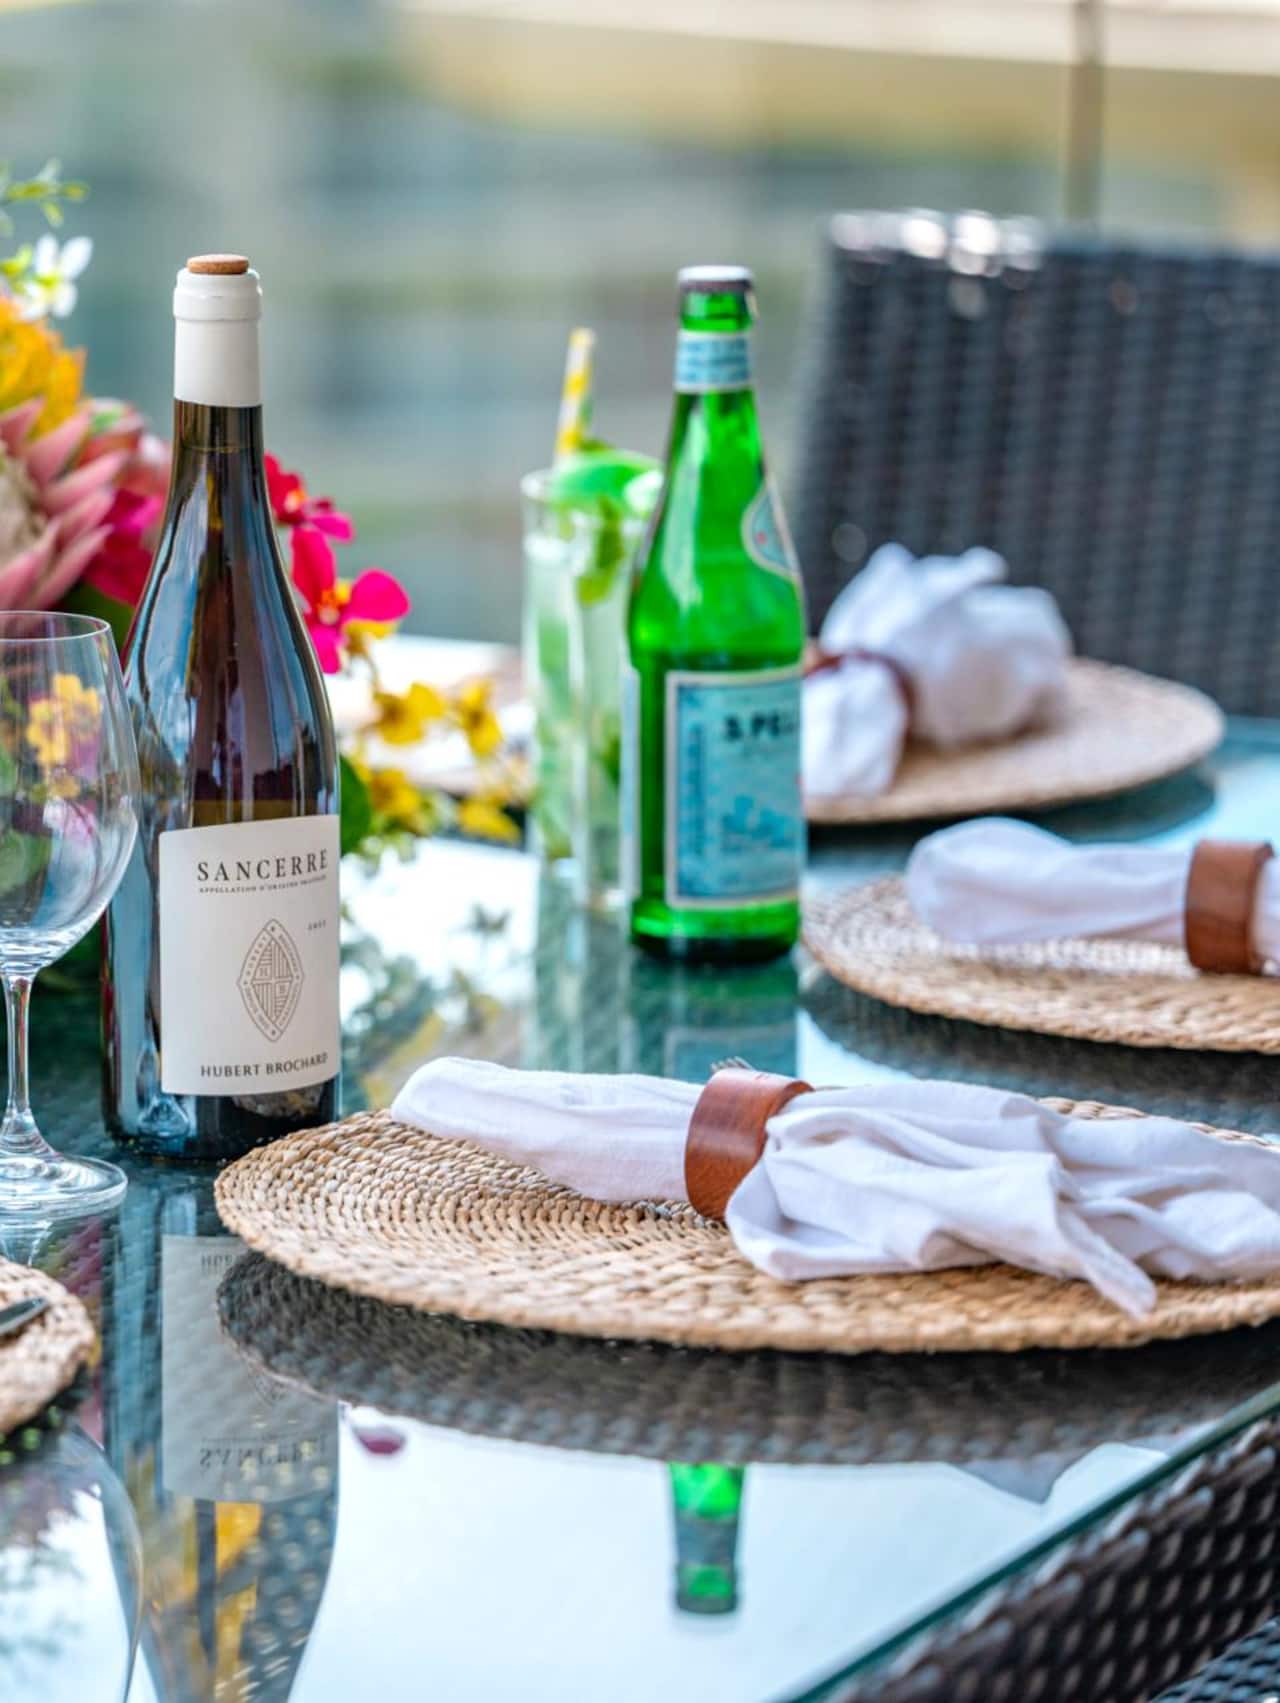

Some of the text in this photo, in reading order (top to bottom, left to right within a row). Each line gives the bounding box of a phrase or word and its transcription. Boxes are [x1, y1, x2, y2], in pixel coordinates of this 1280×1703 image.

[197, 849, 327, 881] SANCERRE
[200, 1052, 327, 1077] HUBERT BROCHARD
